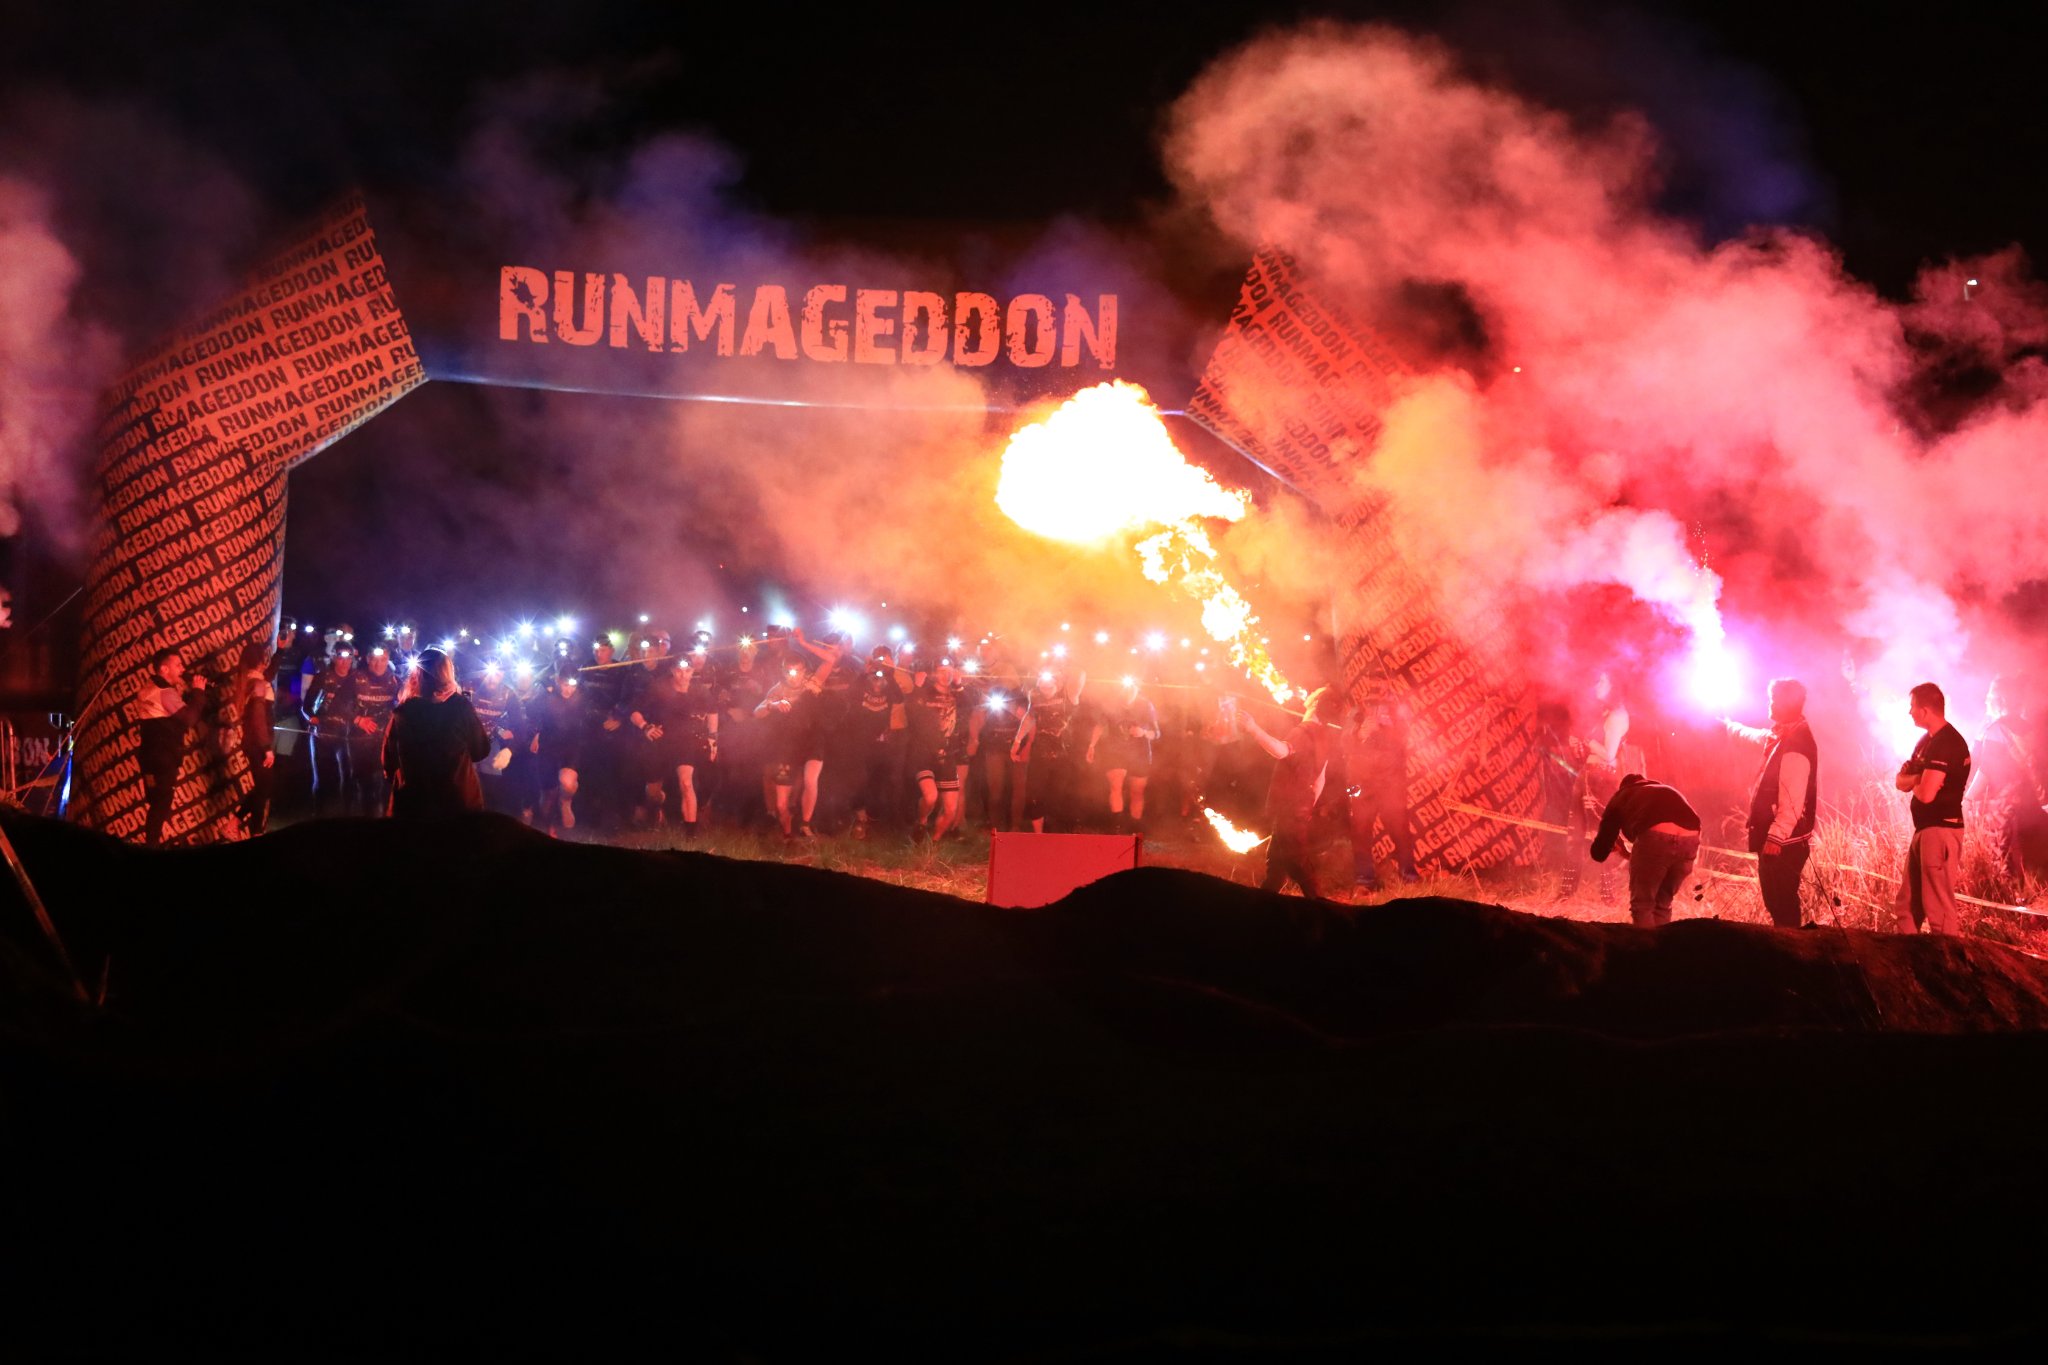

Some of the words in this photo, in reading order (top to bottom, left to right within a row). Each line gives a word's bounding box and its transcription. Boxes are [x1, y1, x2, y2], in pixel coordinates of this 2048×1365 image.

[195, 306, 364, 388] RUNMAGEDDON
[499, 265, 1119, 370] RUNMAGEDDON
[217, 354, 384, 438] RUNMAGEDDON
[117, 453, 247, 535] RUNMAGEDDON
[135, 495, 263, 579] RUNMAGEDDON
[156, 538, 275, 622] RUNMAGEDDON
